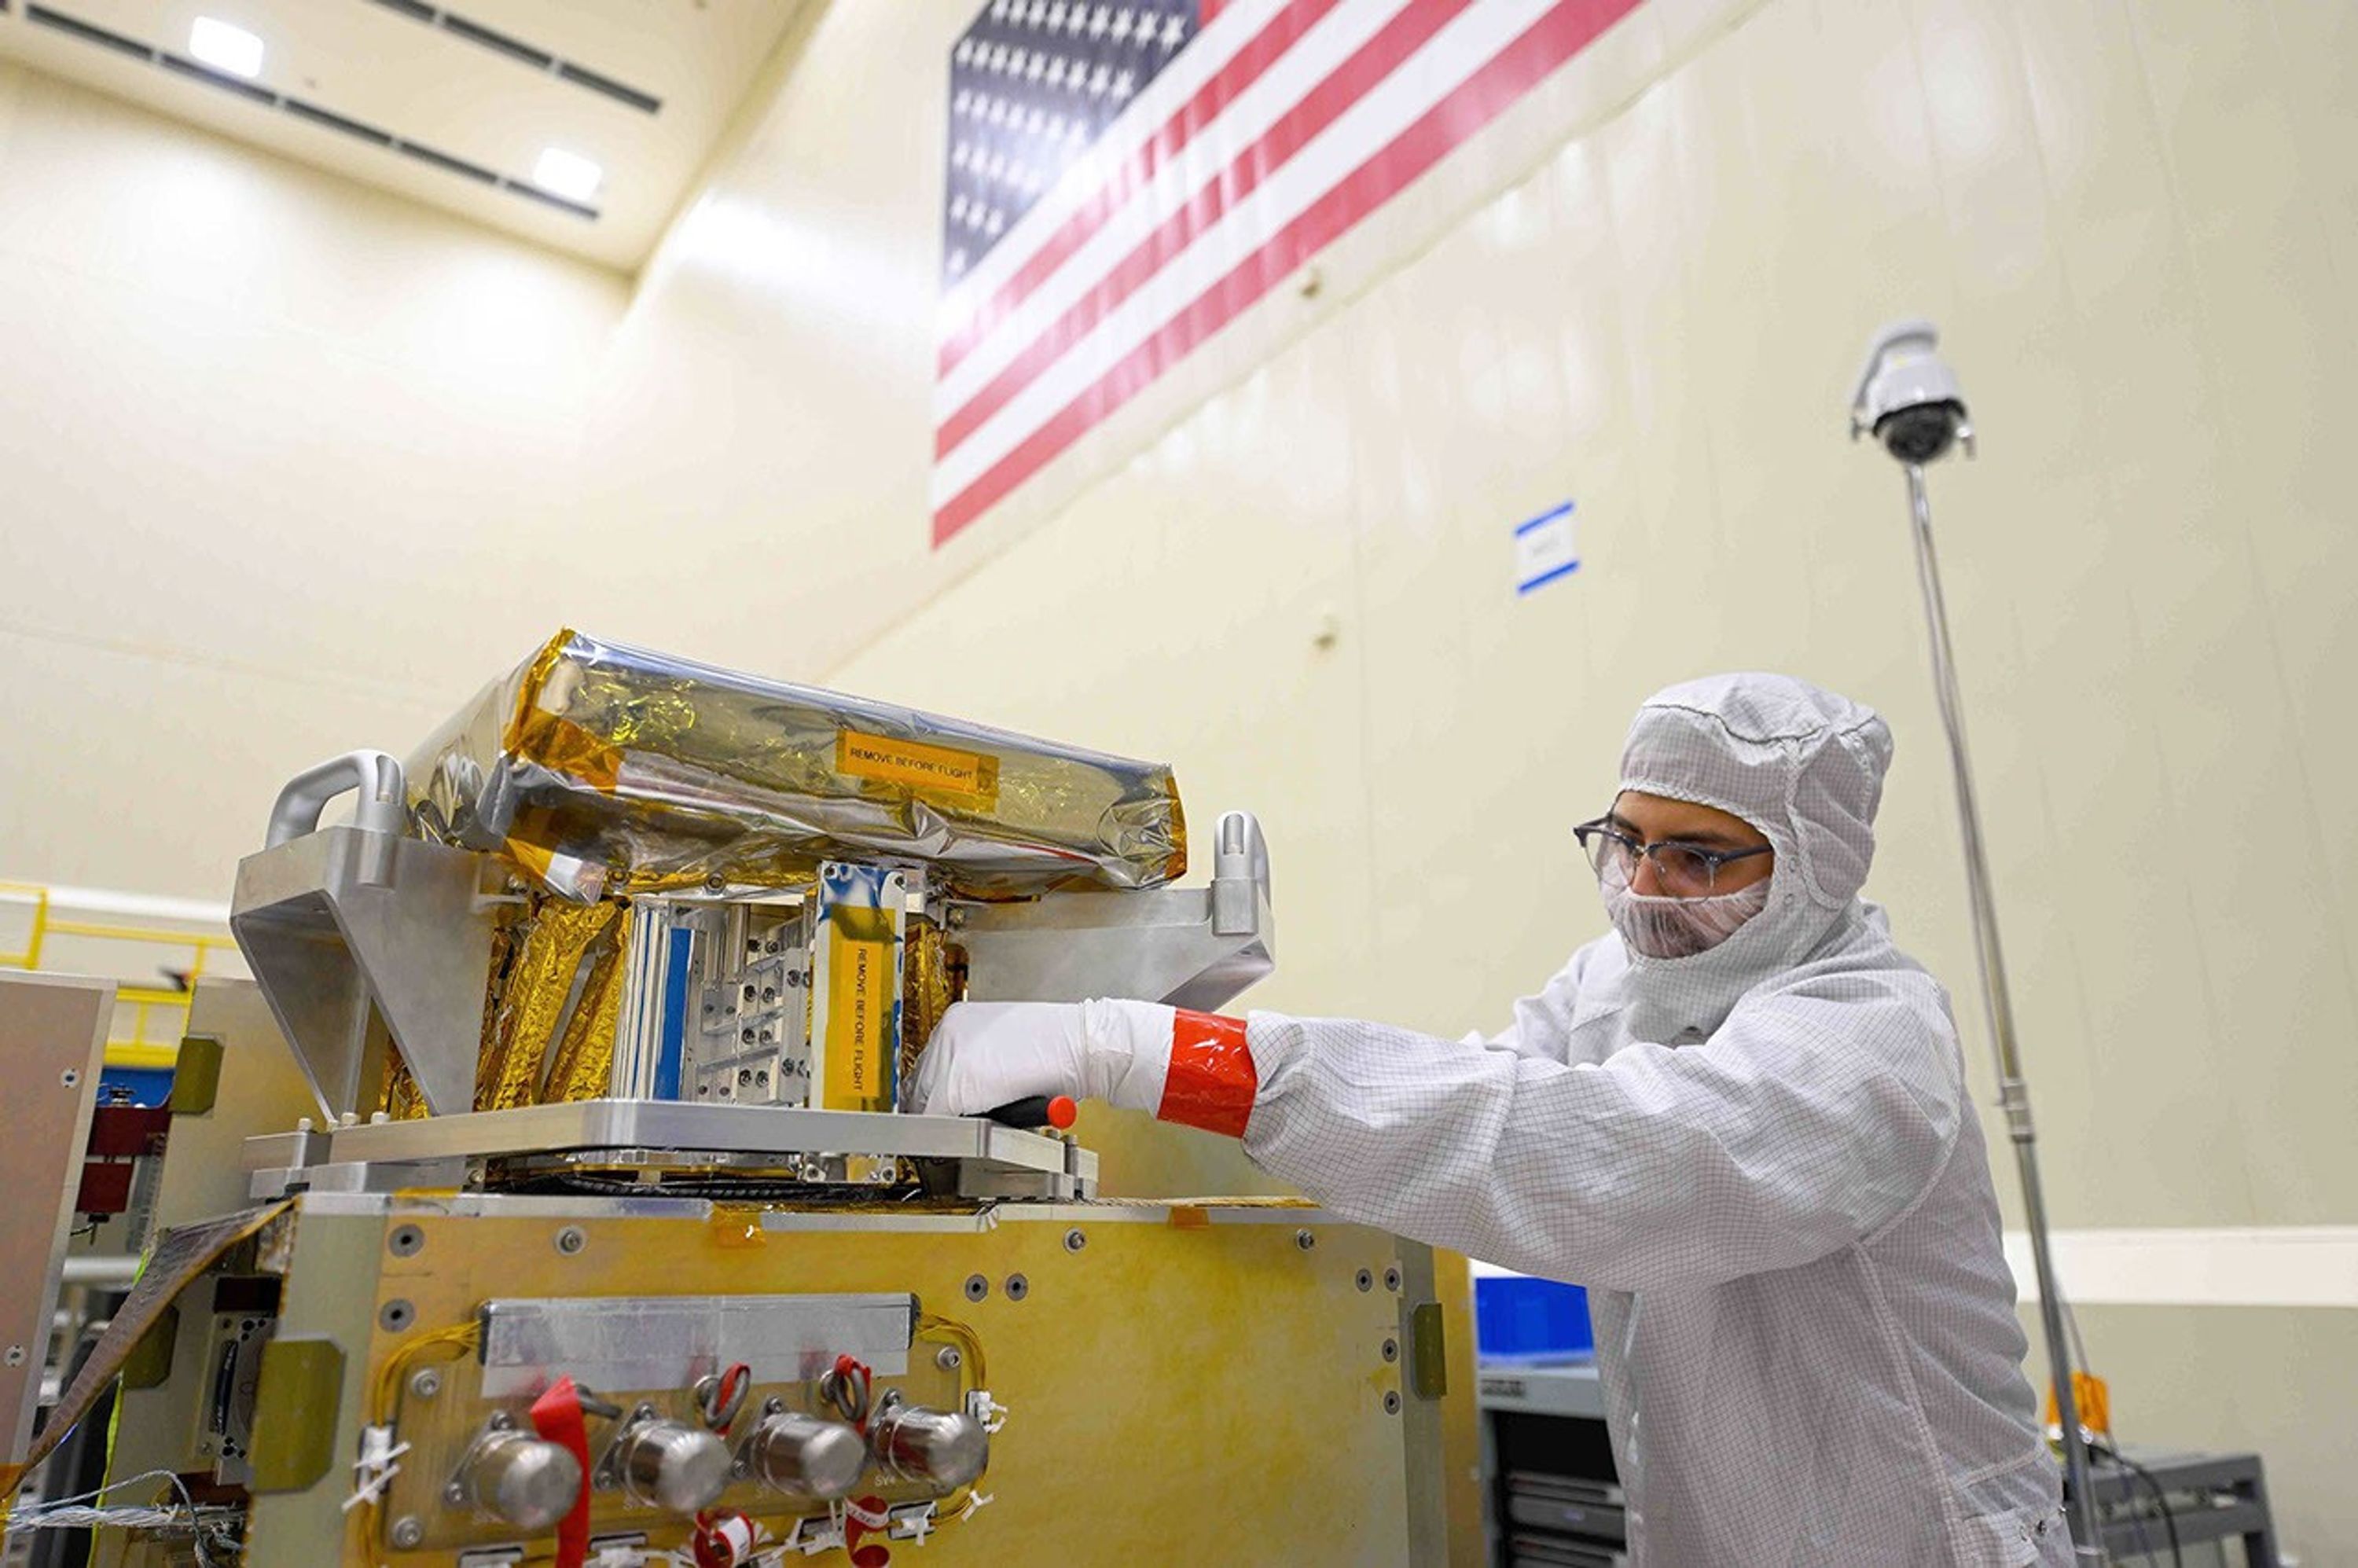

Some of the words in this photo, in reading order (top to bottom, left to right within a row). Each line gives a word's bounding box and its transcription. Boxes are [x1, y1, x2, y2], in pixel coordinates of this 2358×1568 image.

[850, 747, 892, 765] REMOVE
[895, 756, 935, 772] BEFORE
[938, 765, 972, 780] FLIGHT
[856, 948, 867, 997] REMOVE
[854, 1000, 865, 1046] BEFORE
[854, 1049, 864, 1091] FLIGHT
